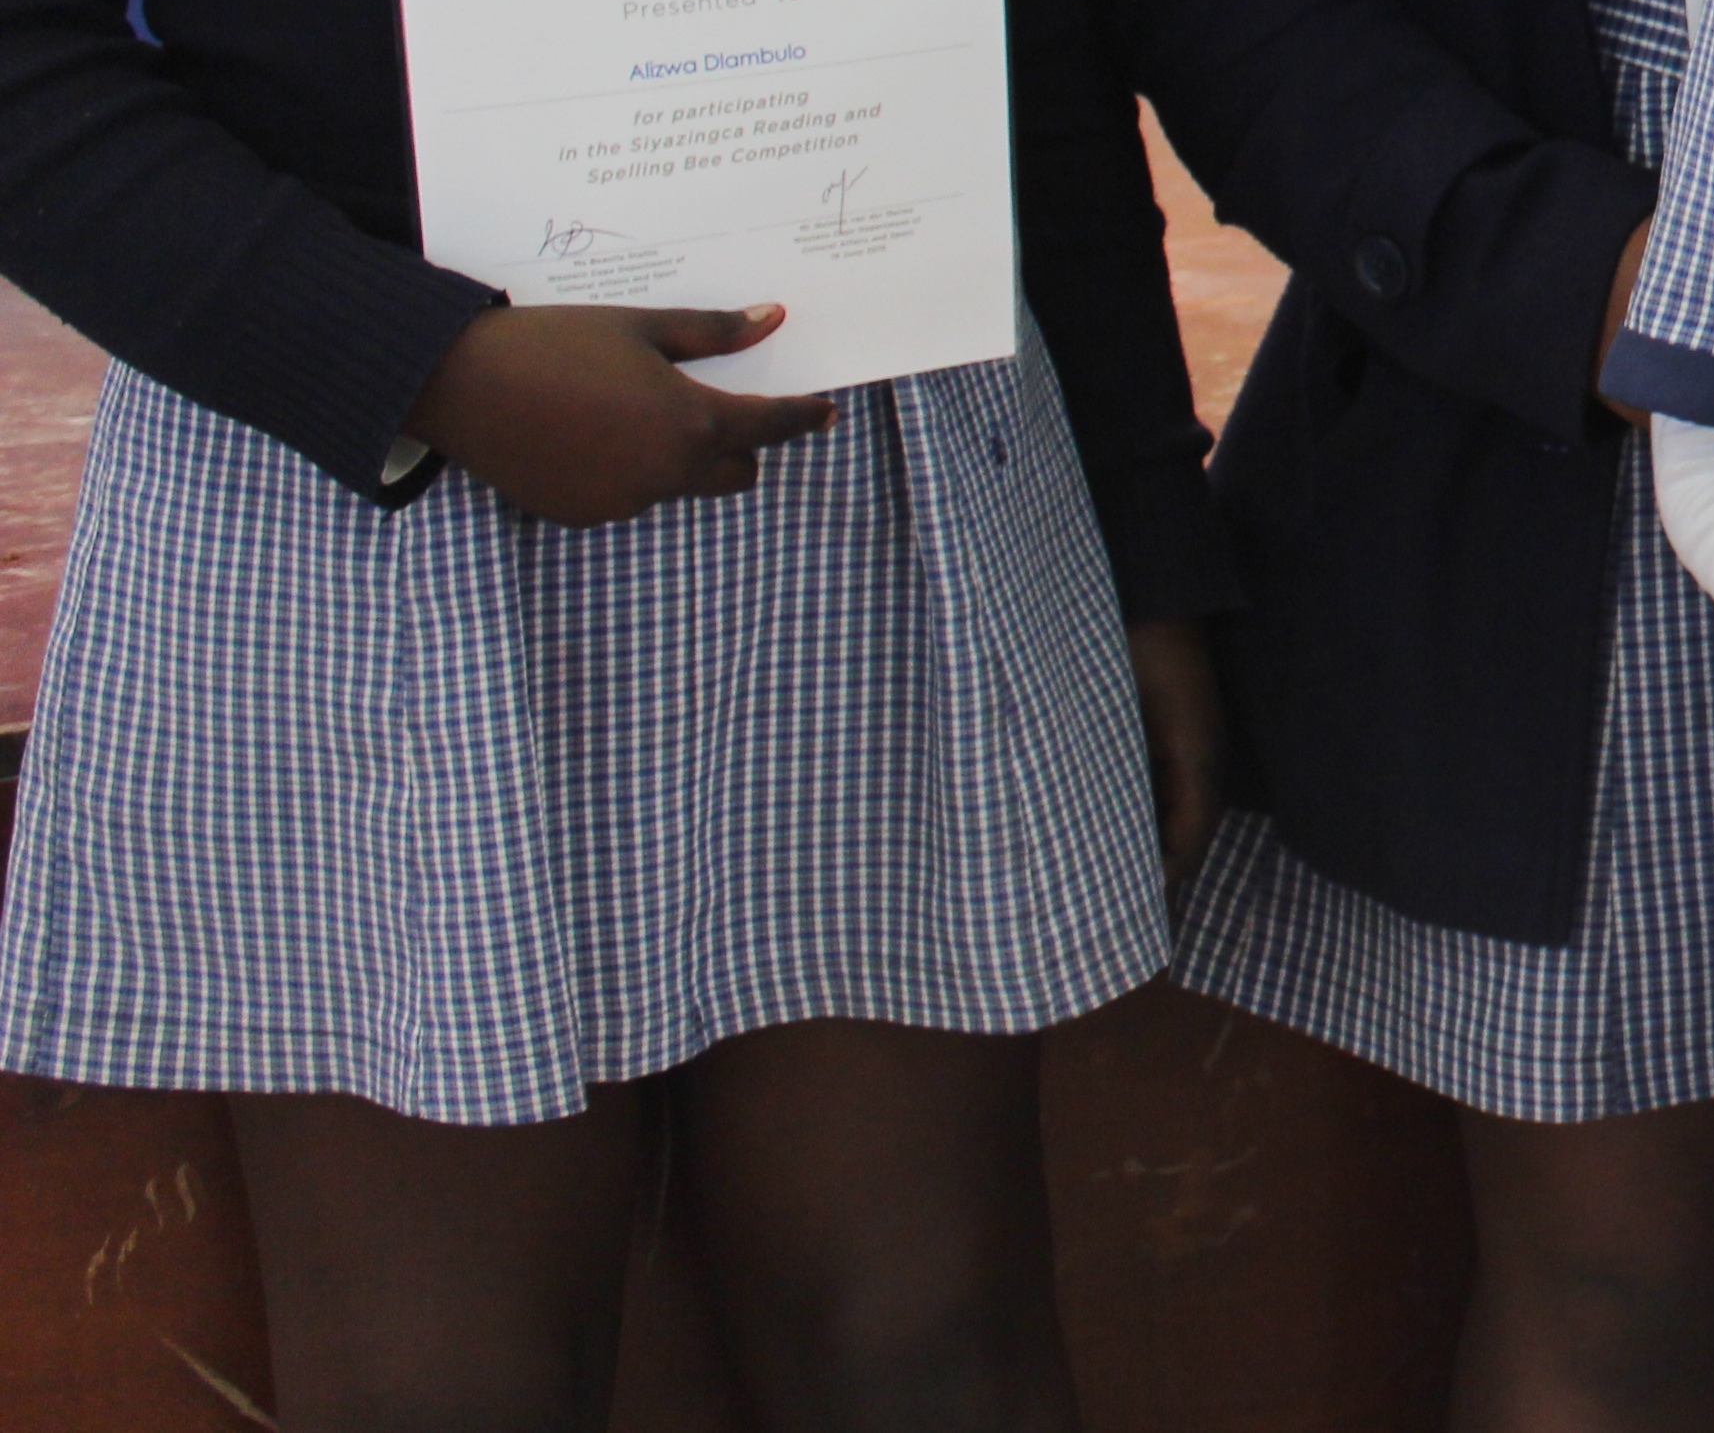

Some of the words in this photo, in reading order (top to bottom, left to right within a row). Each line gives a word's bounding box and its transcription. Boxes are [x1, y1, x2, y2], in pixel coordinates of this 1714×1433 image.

[628, 56, 698, 81] Alizwa
[703, 43, 807, 73] Dlambulo
[558, 146, 578, 162] in
[587, 140, 622, 159] the
[752, 109, 838, 136] Reading
[844, 102, 883, 125] and
[633, 109, 665, 126] for
[671, 91, 810, 125] participating
[586, 159, 676, 186] Spelling
[683, 153, 723, 172] Bee
[731, 130, 860, 165] Competition
